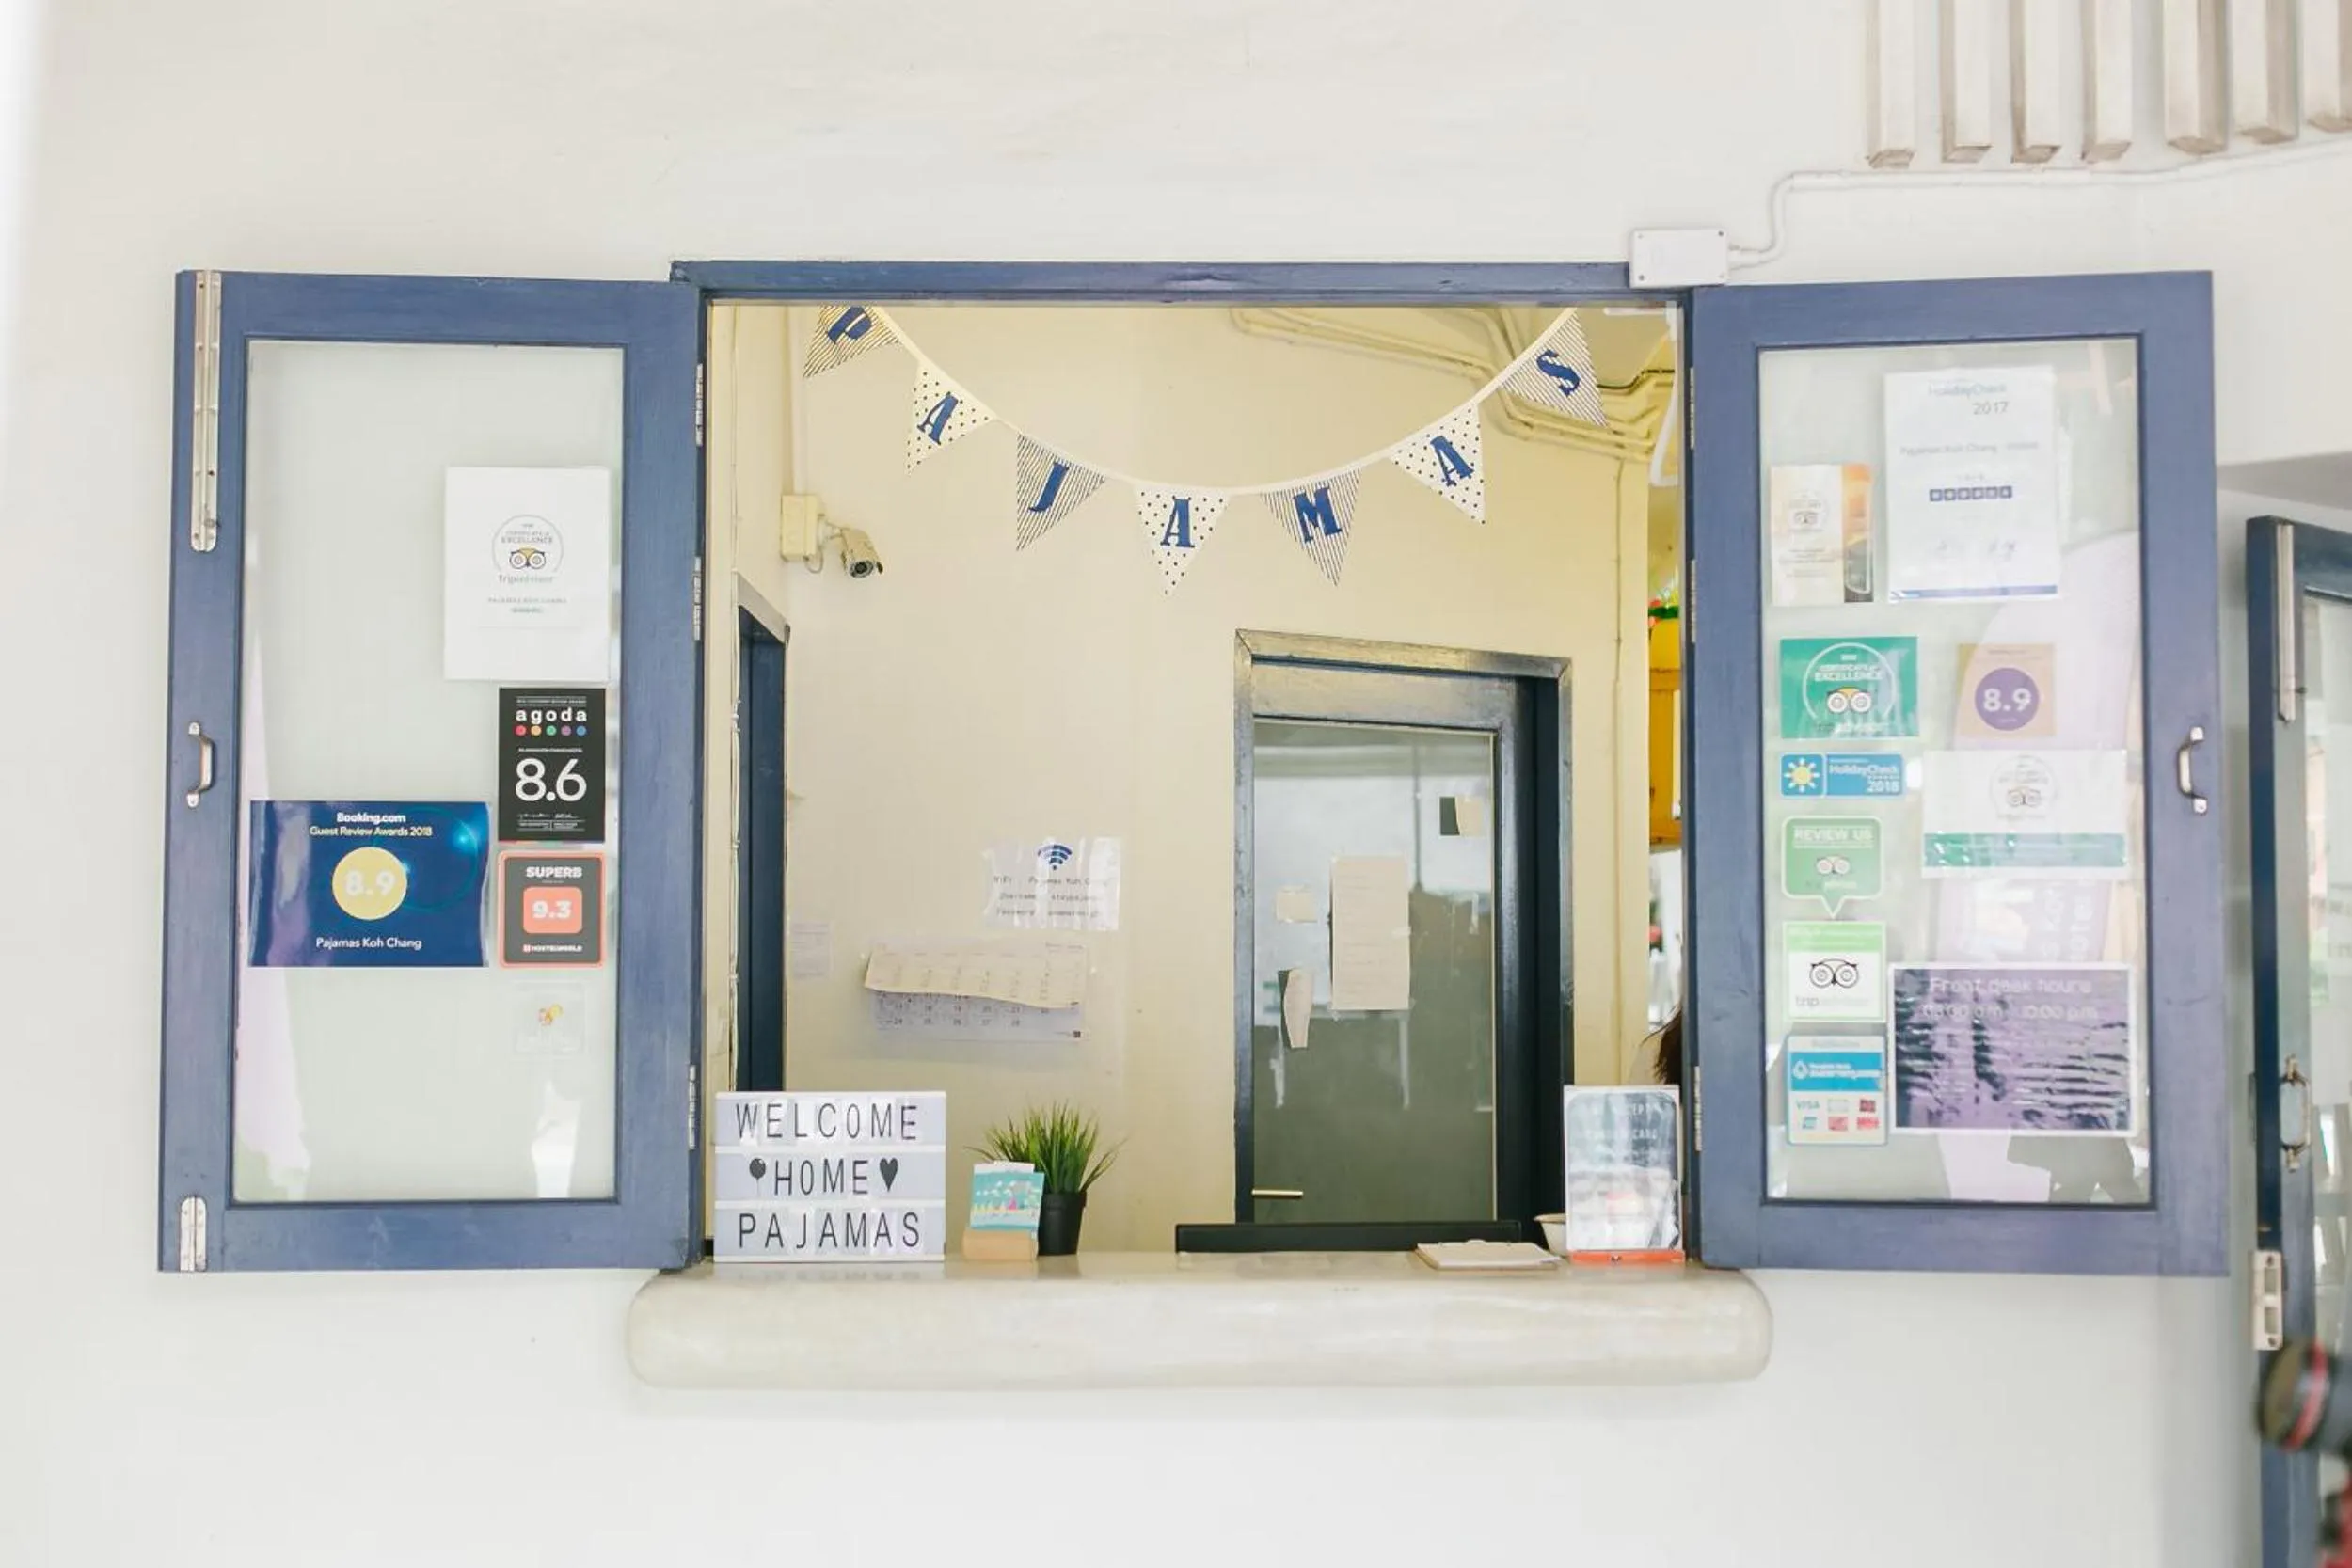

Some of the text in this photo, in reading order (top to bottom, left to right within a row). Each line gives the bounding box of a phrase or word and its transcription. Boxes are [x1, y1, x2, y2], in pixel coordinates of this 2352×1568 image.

[1974, 401, 2010, 415] 2017
[1982, 687, 2032, 712] 8.9
[516, 707, 587, 724] agoda
[515, 757, 587, 802] 8.6
[336, 812, 406, 825] Booking.com
[310, 826, 433, 836] Guest Review Awards 2018
[1793, 829, 1849, 842] REVIEW
[526, 866, 582, 878] SUPERB
[345, 869, 396, 895] 8.9
[532, 900, 572, 919] 9.3
[315, 937, 422, 950] Pajamas Koh Chang
[736, 1103, 918, 1140] WELCOME
[773, 1158, 869, 1196] HOME
[739, 1211, 921, 1250] PAJAMAS
